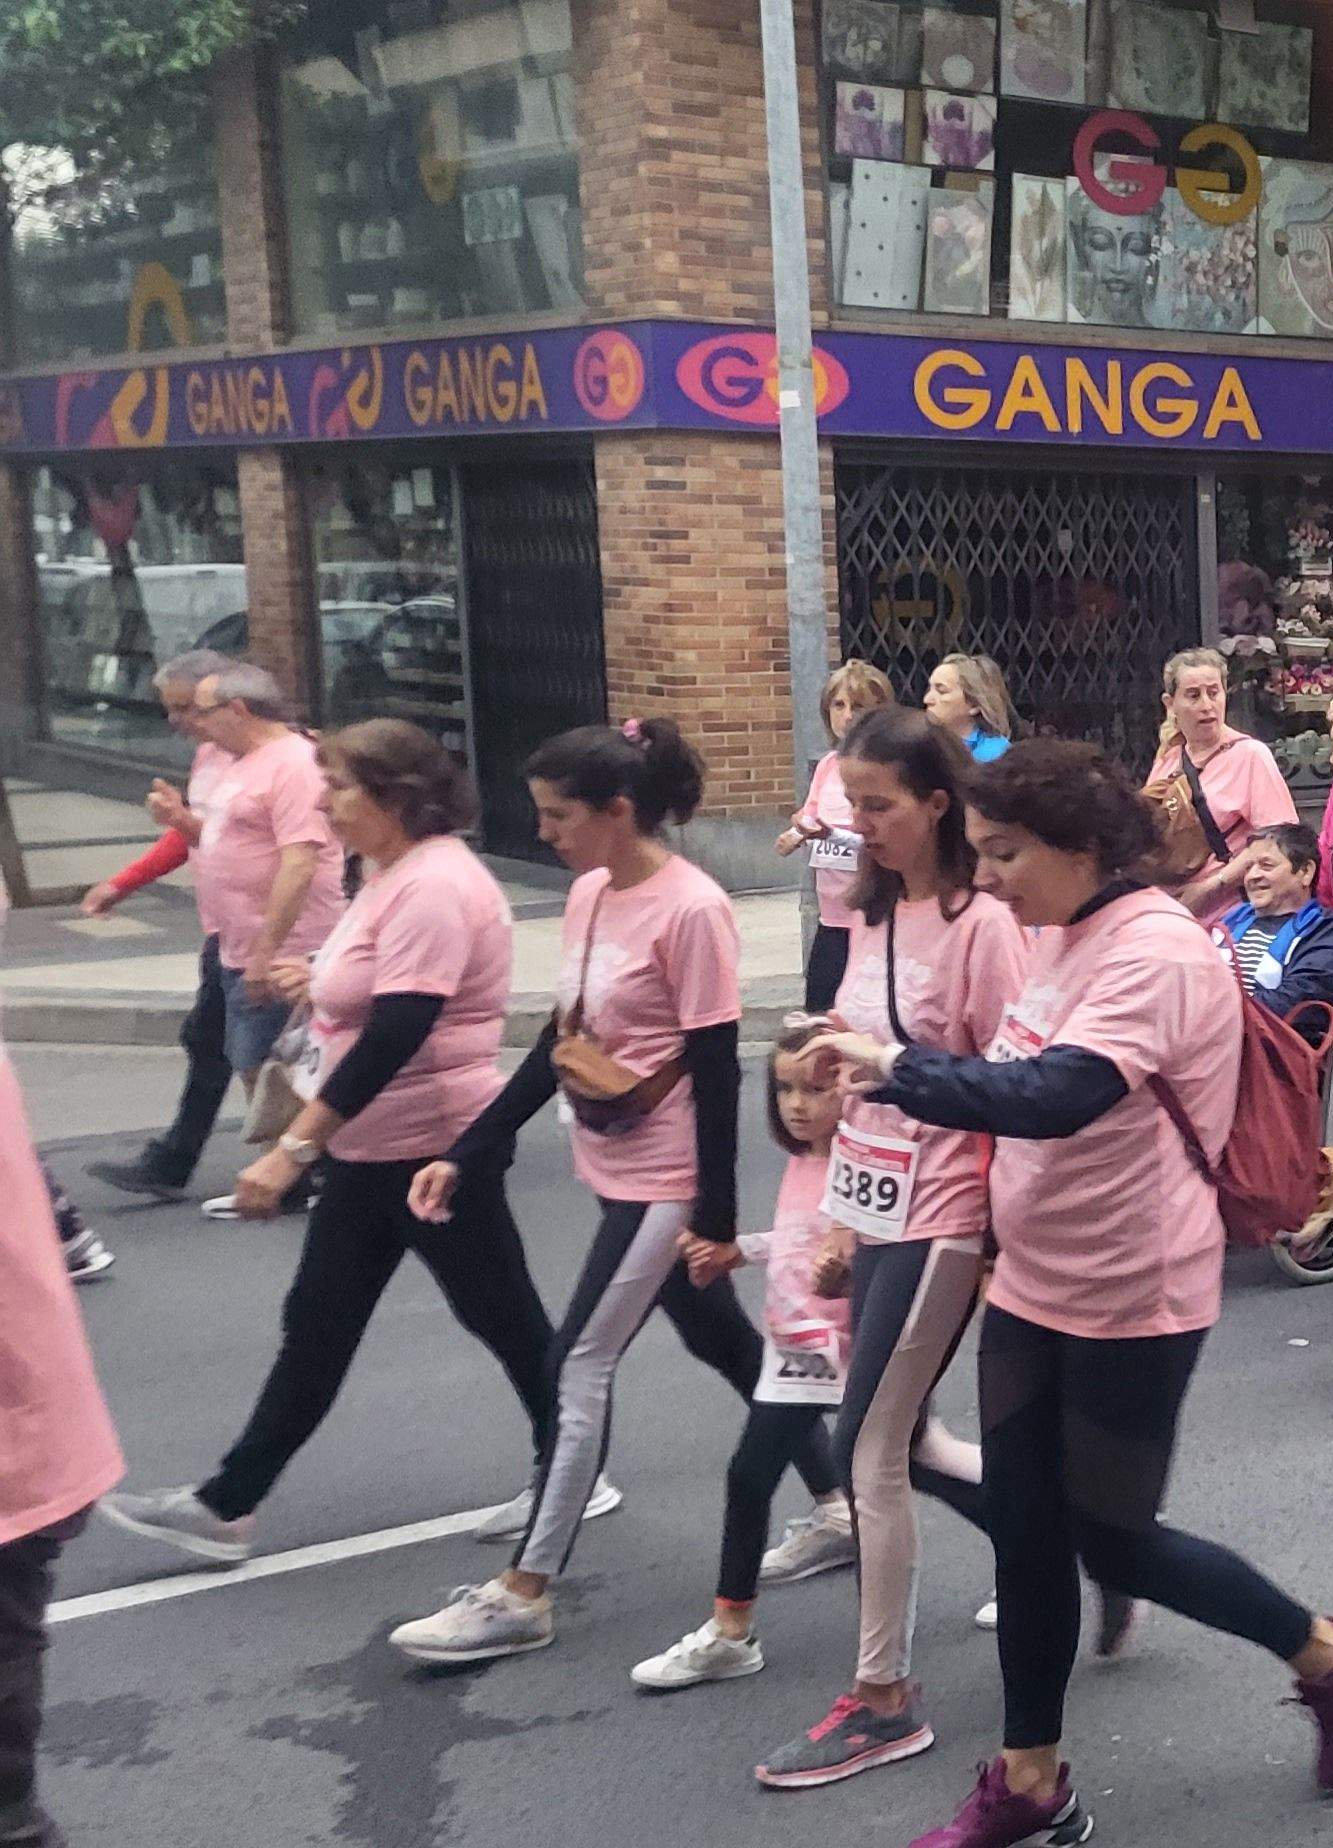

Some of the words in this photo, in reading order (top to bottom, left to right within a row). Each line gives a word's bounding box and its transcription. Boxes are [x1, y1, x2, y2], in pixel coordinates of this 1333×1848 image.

[186, 365, 294, 435] GANGA
[404, 343, 548, 426] GANGA
[913, 348, 1263, 441] GANGA
